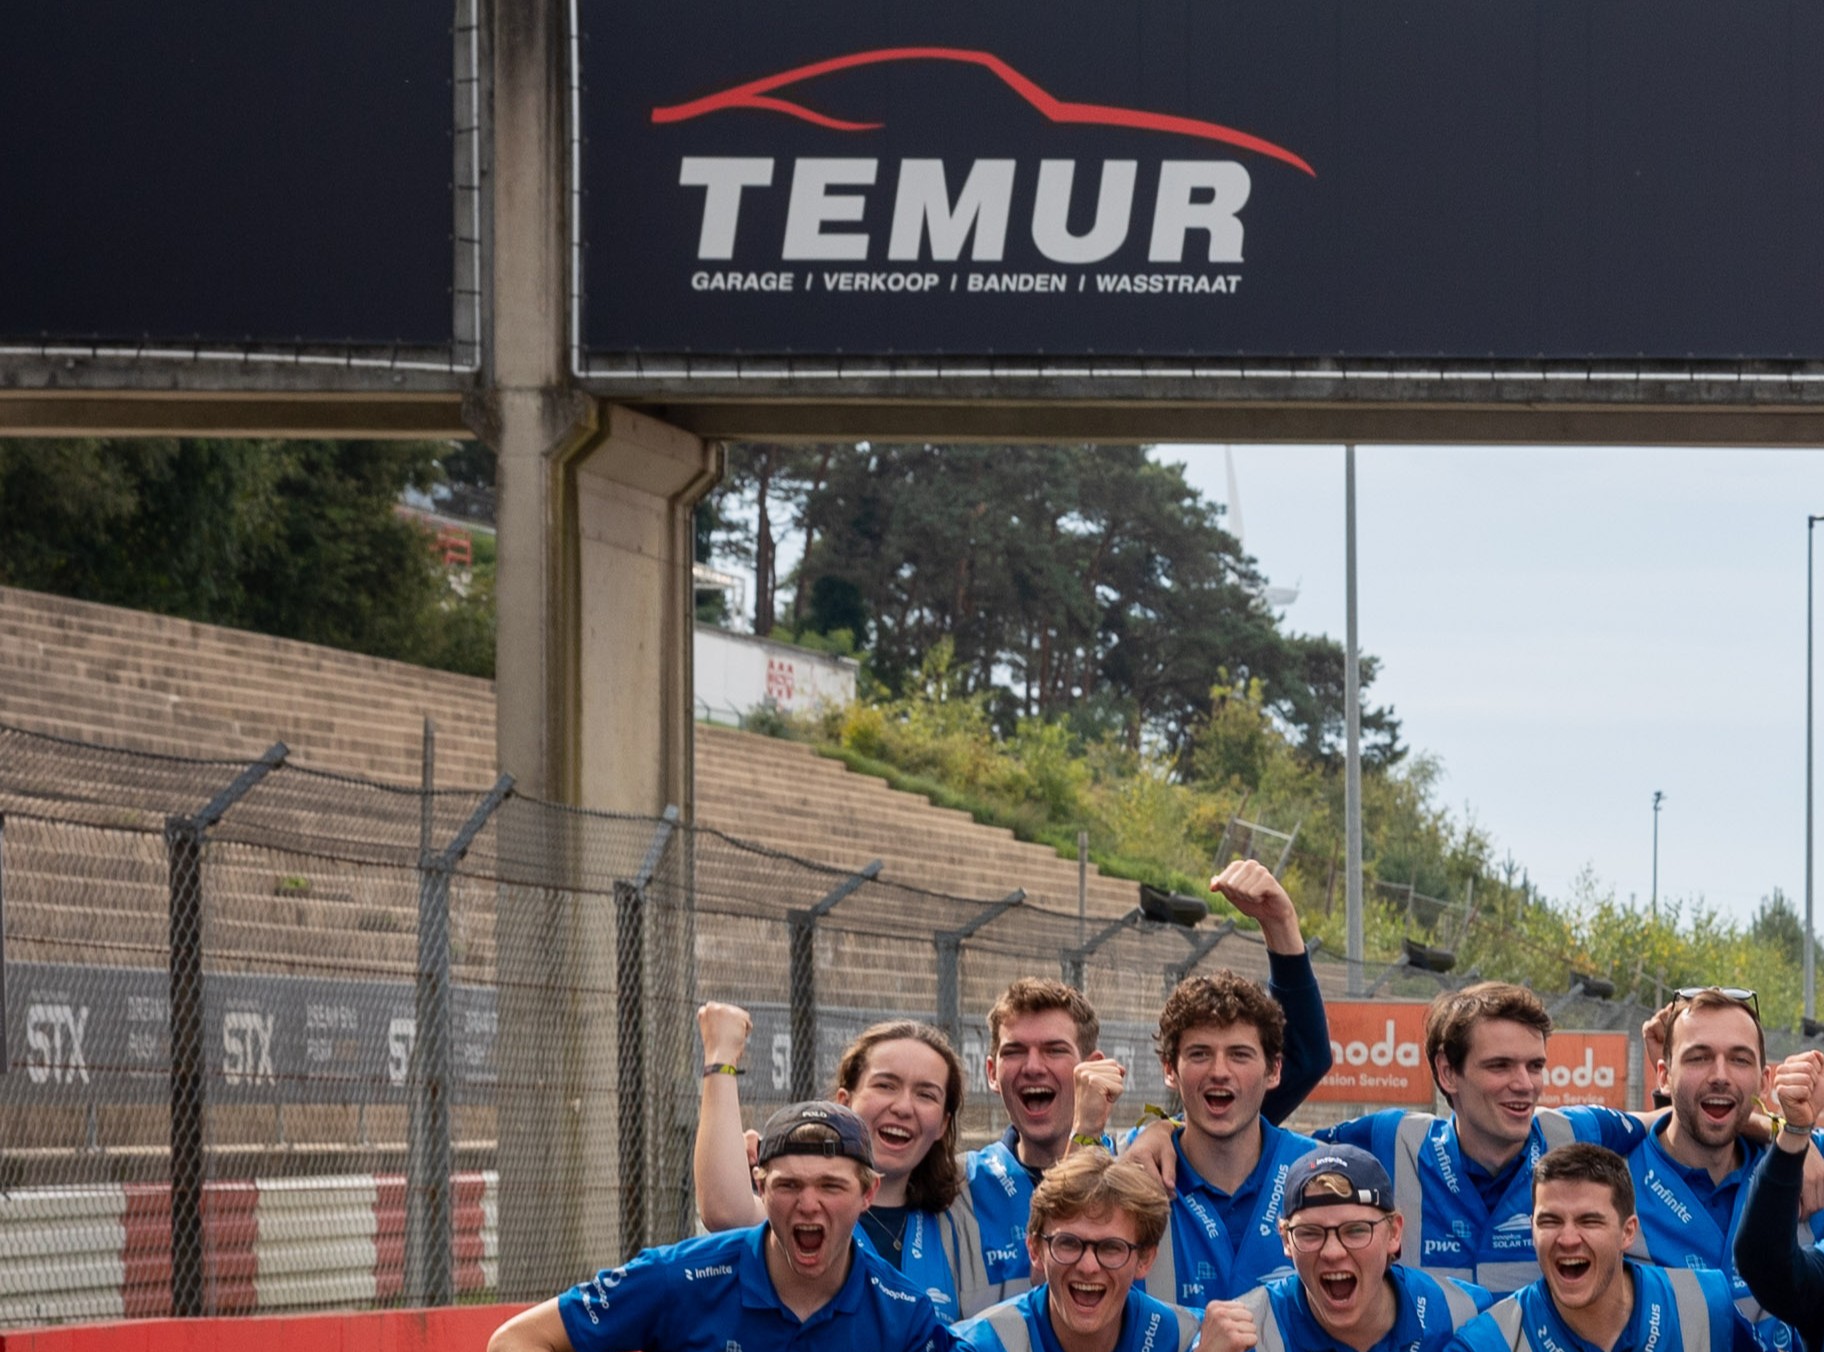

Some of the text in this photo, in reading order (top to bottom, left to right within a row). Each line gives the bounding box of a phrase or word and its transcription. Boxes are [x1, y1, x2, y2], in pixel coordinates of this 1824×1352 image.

[679, 157, 1252, 263] TEMUR
[691, 271, 1242, 294] GARAGE VERKOOP BANDEN WASSTRAAT
[26, 1004, 90, 1085] STX
[223, 1012, 276, 1085] STX
[1315, 1155, 1348, 1168] infinite
[1266, 1163, 1289, 1223] innoptus
[1425, 1239, 1461, 1255] pwc
[696, 1264, 733, 1279] infinite
[879, 1280, 916, 1302] innoptus
